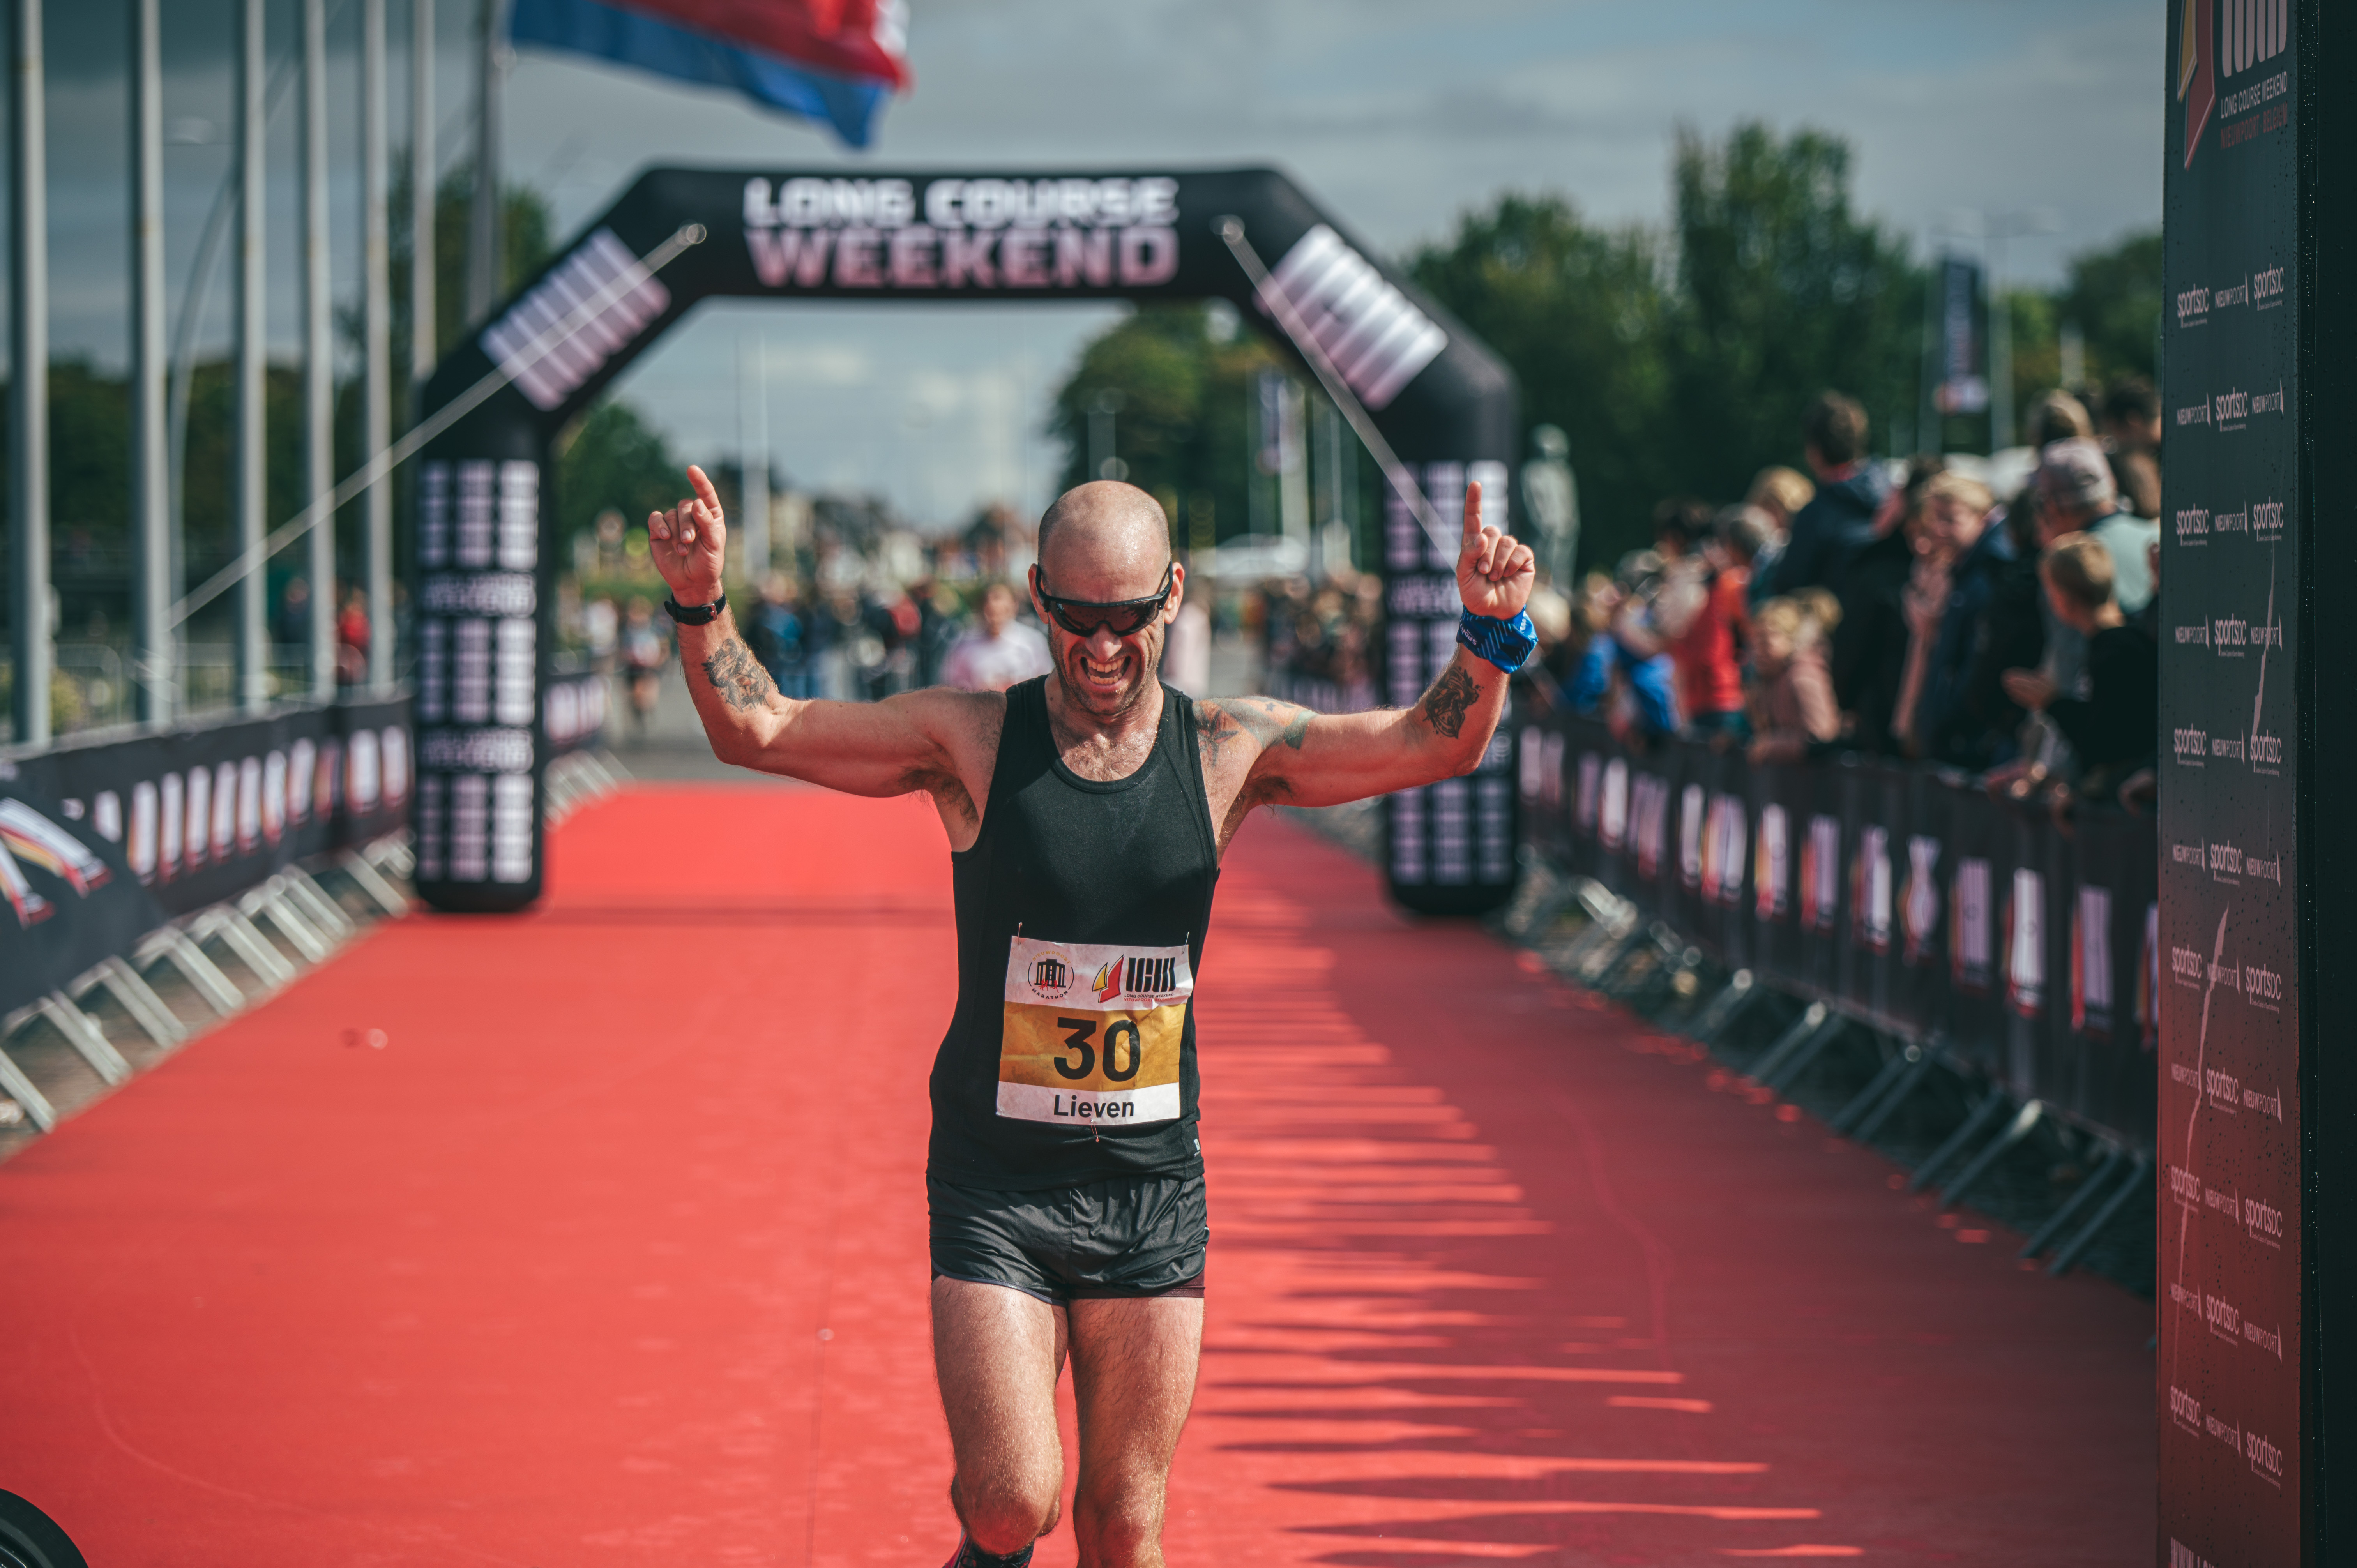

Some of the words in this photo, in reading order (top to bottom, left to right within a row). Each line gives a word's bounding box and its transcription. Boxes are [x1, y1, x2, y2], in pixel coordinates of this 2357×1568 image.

[2221, 94, 2237, 119] LONG
[2239, 83, 2260, 112] COURSE
[2262, 71, 2287, 102] WEEKEND
[2221, 114, 2259, 150] NIEUWPOORT
[2263, 101, 2287, 133] BELGIUM
[743, 177, 915, 228] LONG
[924, 176, 1179, 229] COURSE
[744, 225, 1179, 287] WEEKEND
[2215, 285, 2245, 308] NIEUWPOORT
[2252, 392, 2279, 414] NIEUWPOORT
[2177, 405, 2207, 425] NIEUWPOORT
[2215, 513, 2244, 532] NIEUWPOORT
[2212, 739, 2241, 758] NIEUWPOORT
[2246, 857, 2276, 880] NIEUWPOORT
[1032, 951, 1071, 964] NIEUWPOORT
[1032, 988, 1068, 999] MARATHON
[1054, 1017, 1141, 1082] 30
[1053, 1094, 1134, 1118] Lieven
[2244, 1088, 2277, 1116] NIEUWPOORT
[2244, 1321, 2277, 1353] NIEUWPOORT
